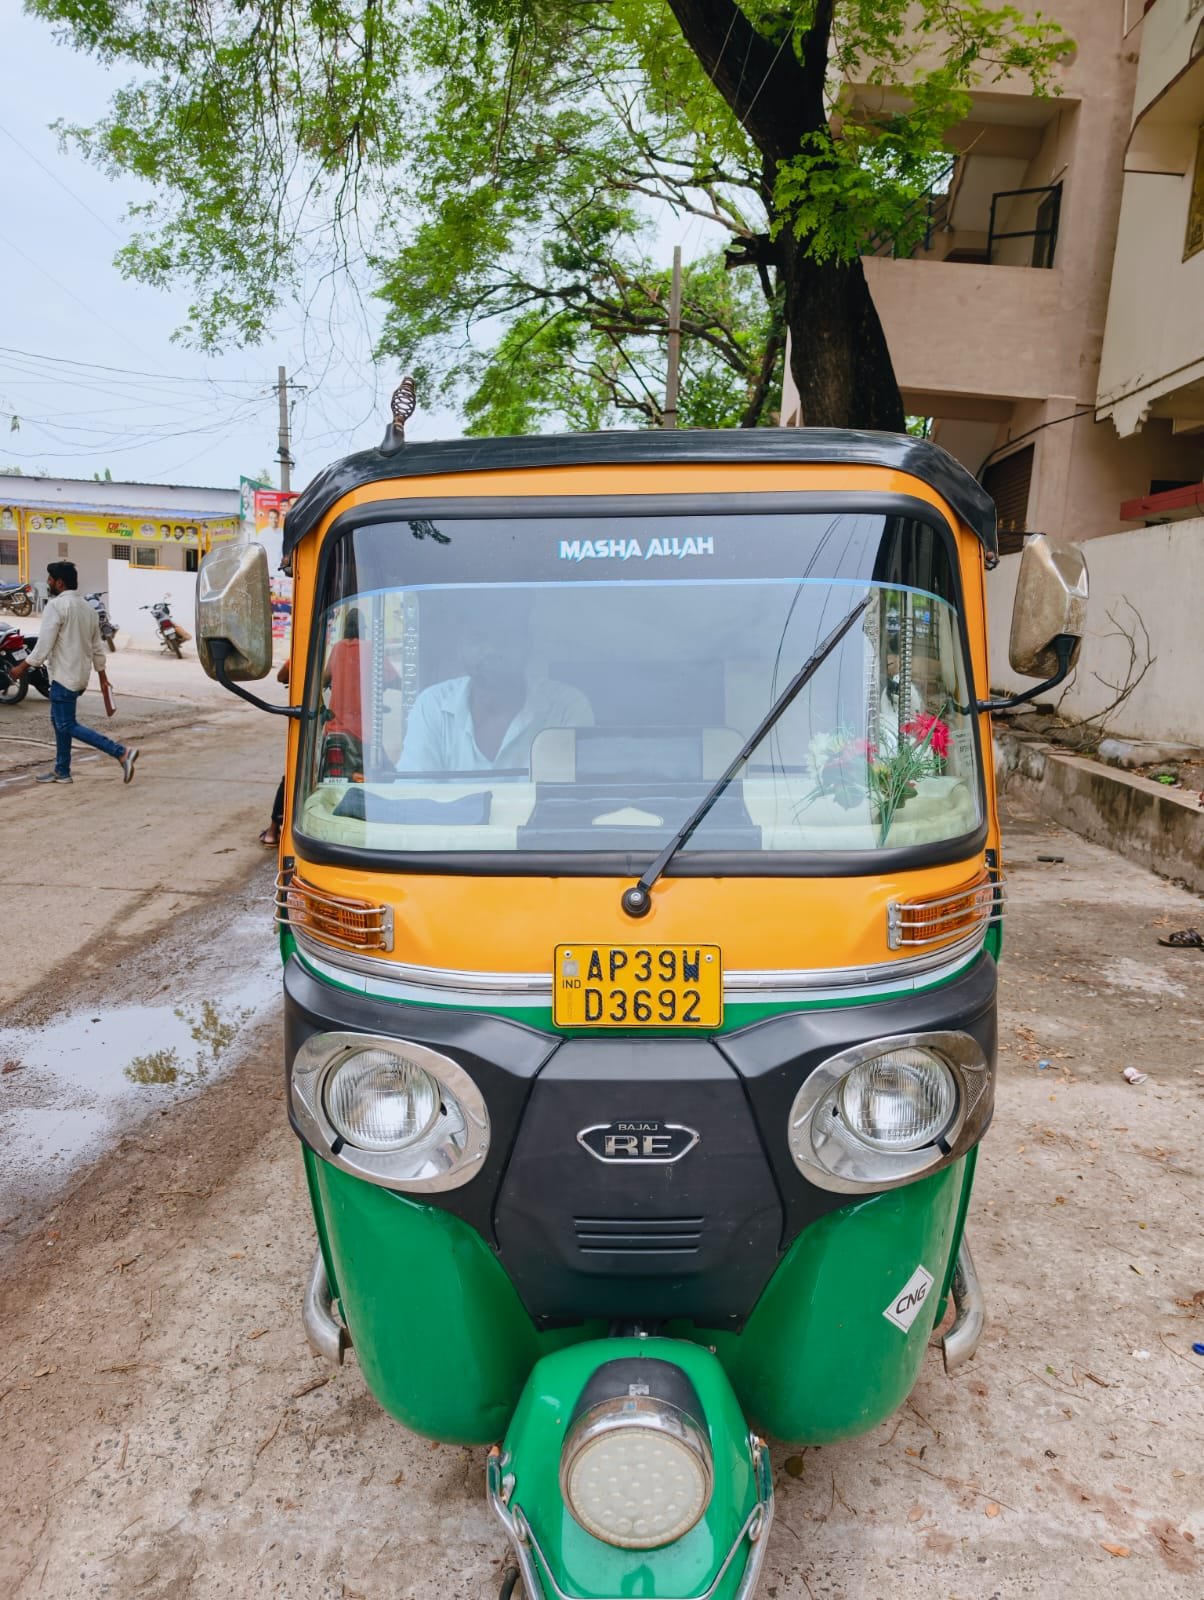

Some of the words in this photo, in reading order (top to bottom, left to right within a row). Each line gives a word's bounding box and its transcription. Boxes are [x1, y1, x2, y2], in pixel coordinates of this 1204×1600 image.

[559, 538, 642, 563] MASHA
[644, 536, 714, 560] ALLAH
[587, 949, 701, 982] AP39W
[562, 979, 582, 989] IND
[584, 988, 701, 1023] D3692
[618, 1123, 658, 1131] BAJAJ
[604, 1135, 672, 1156] RE
[895, 1281, 928, 1315] CNG
